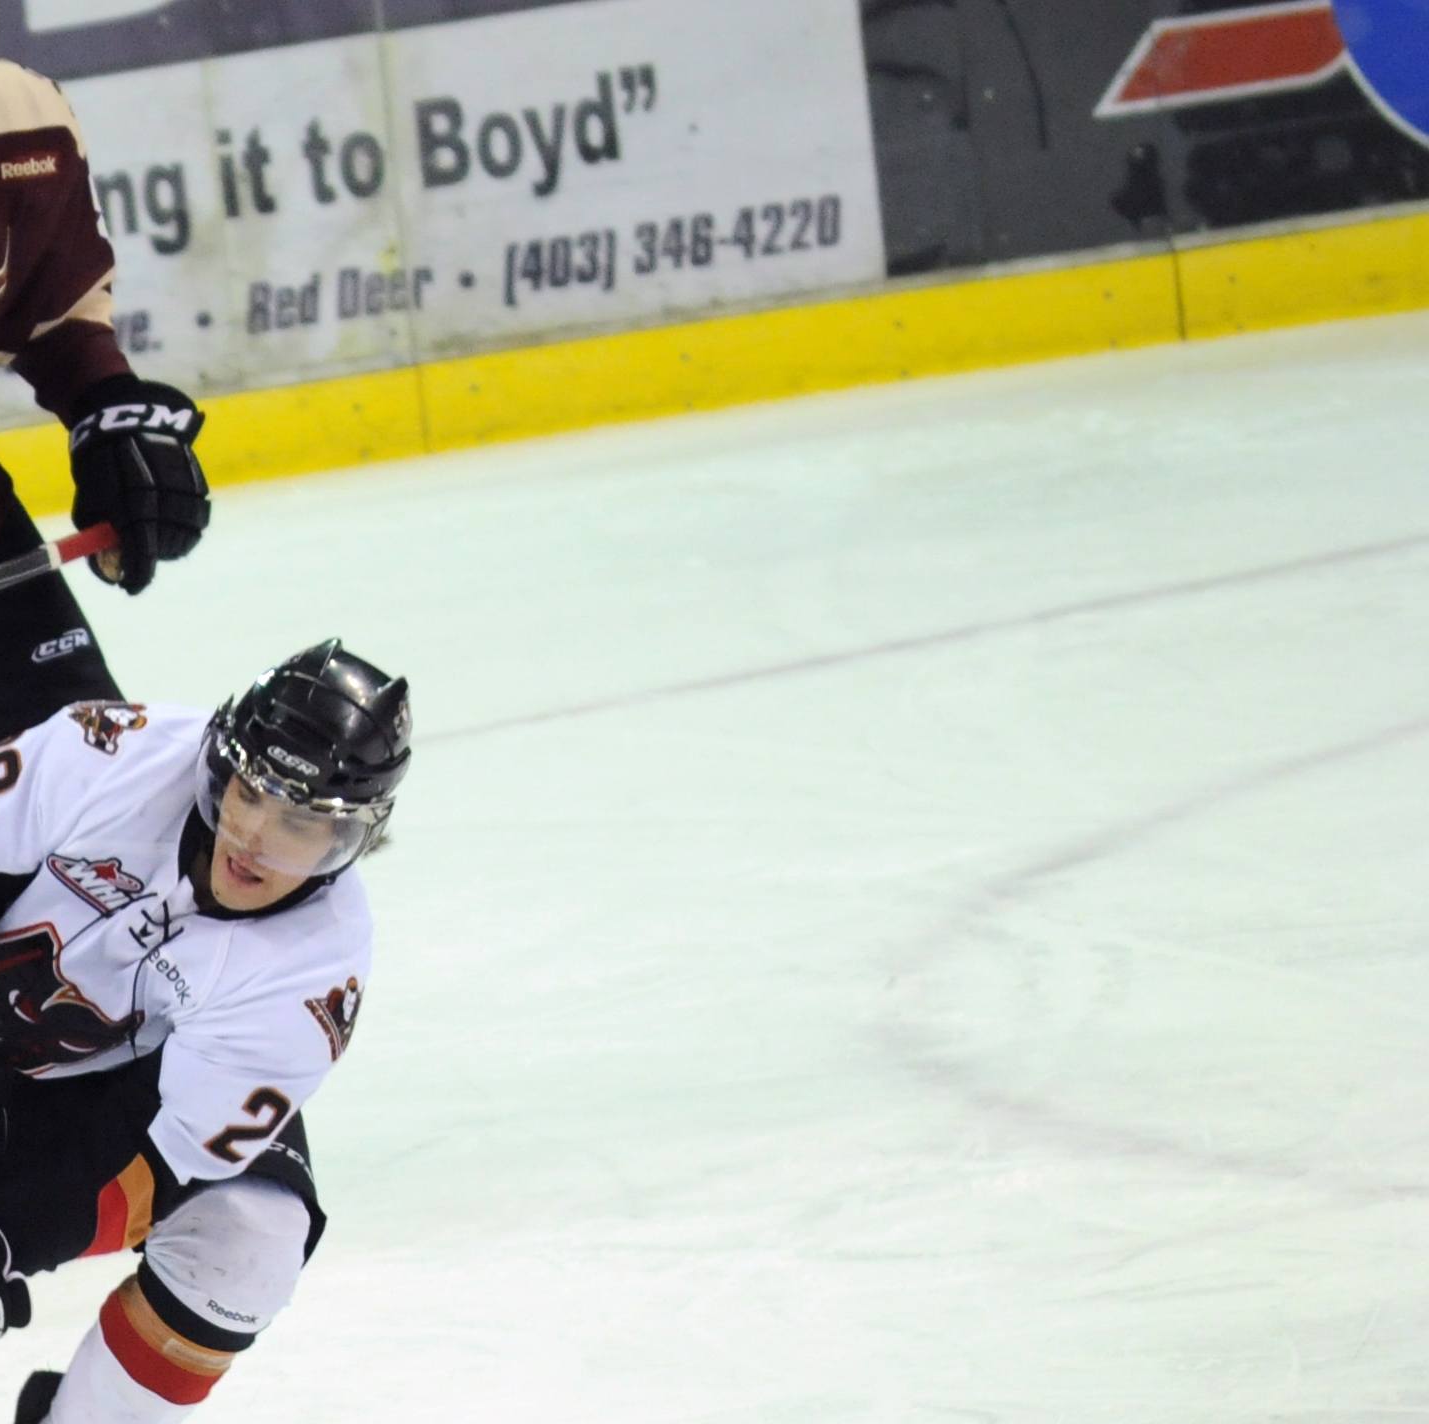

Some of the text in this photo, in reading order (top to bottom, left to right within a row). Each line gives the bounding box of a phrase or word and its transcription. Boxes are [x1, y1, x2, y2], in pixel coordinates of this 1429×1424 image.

[0, 155, 59, 180] Reebok
[217, 128, 275, 217] it
[302, 116, 387, 204] to
[246, 273, 321, 334] Red
[339, 265, 433, 322] Deer
[633, 194, 843, 276] 346-4220
[70, 403, 195, 451] CCM
[147, 947, 192, 1007] eebok
[206, 1297, 259, 1326] Reebok
